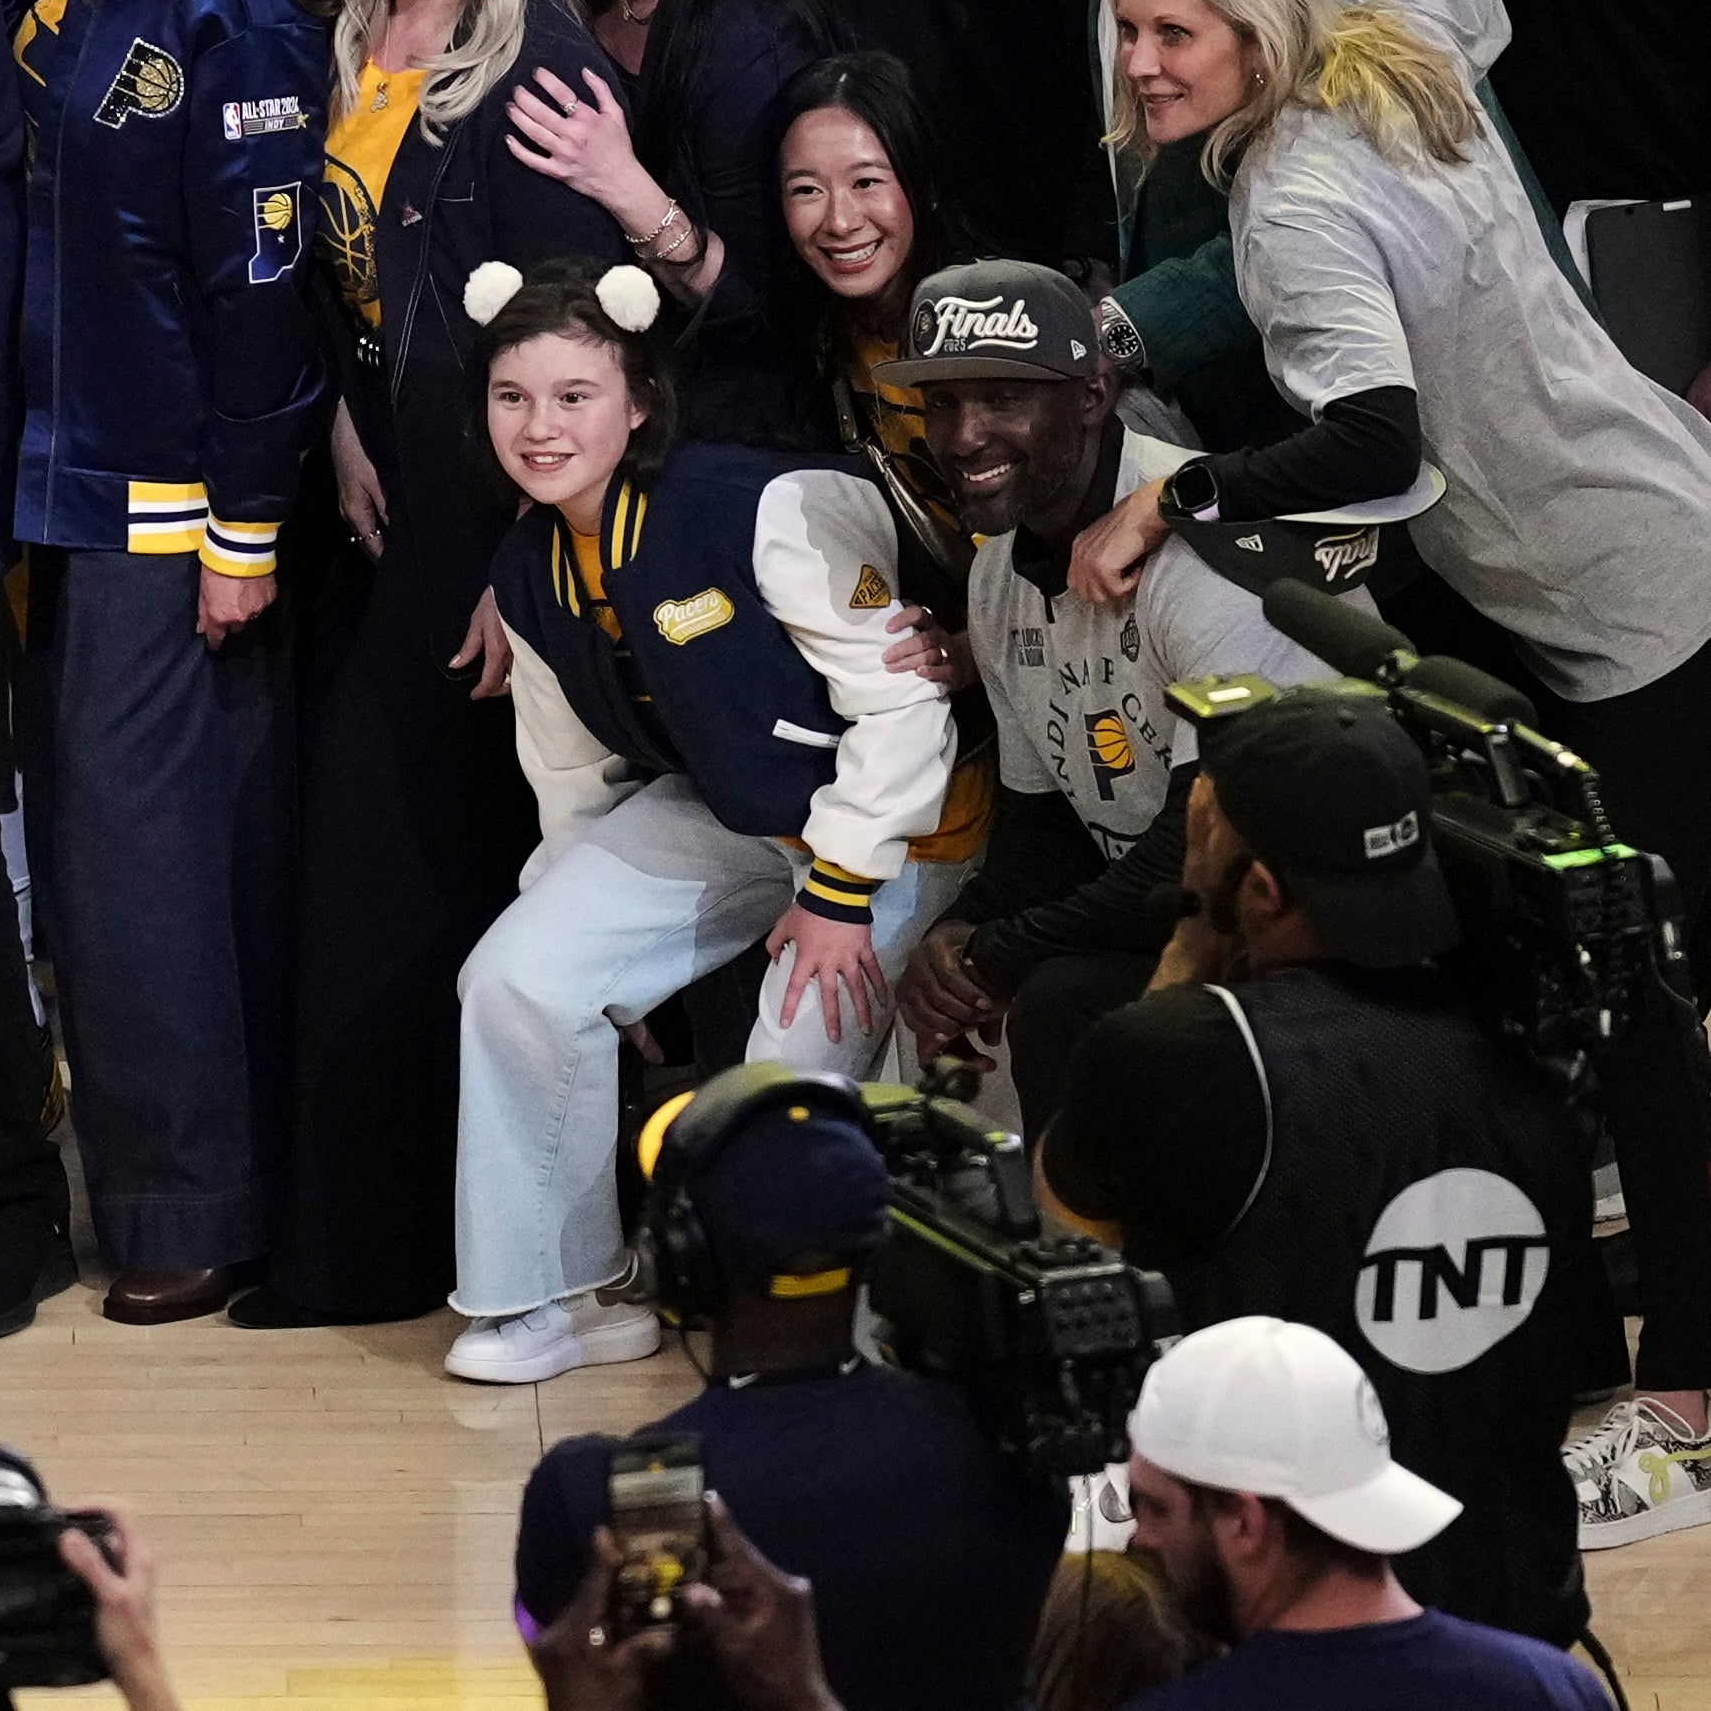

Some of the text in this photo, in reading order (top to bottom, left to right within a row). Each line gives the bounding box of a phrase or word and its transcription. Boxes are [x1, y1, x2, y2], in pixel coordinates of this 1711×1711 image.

[242, 102, 279, 121] ALL-STAR
[924, 296, 1037, 355] Finals
[944, 339, 967, 351] 2025
[1367, 1236, 1545, 1321] TNT
